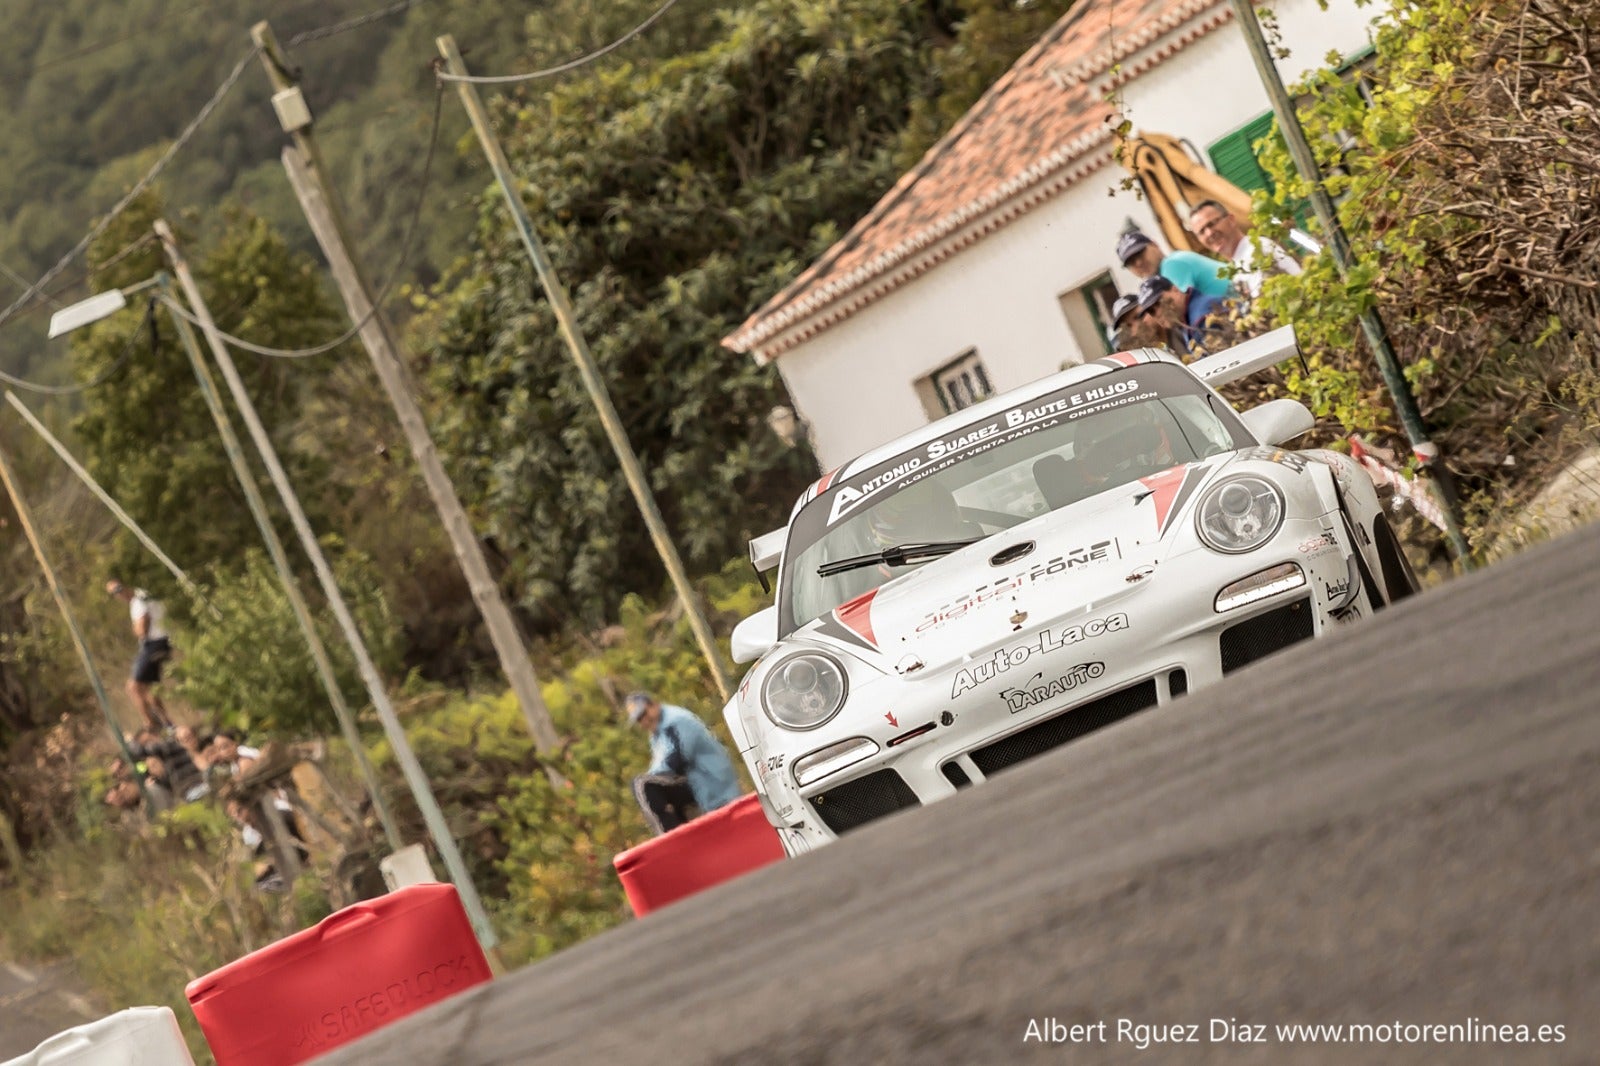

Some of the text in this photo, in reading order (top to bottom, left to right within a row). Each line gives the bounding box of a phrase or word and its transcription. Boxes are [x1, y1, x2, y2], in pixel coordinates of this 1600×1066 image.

[826, 379, 1139, 526] ANTONIO SUAREZ BAUTE E HIJOS
[898, 458, 956, 489] ALQUILER
[957, 453, 965, 461] Y
[967, 438, 1006, 457] VENTA
[1007, 425, 1040, 441] PARA
[1042, 419, 1059, 429] LA
[1030, 549, 1108, 582] FONE
[951, 612, 1130, 699] Auto-Laca
